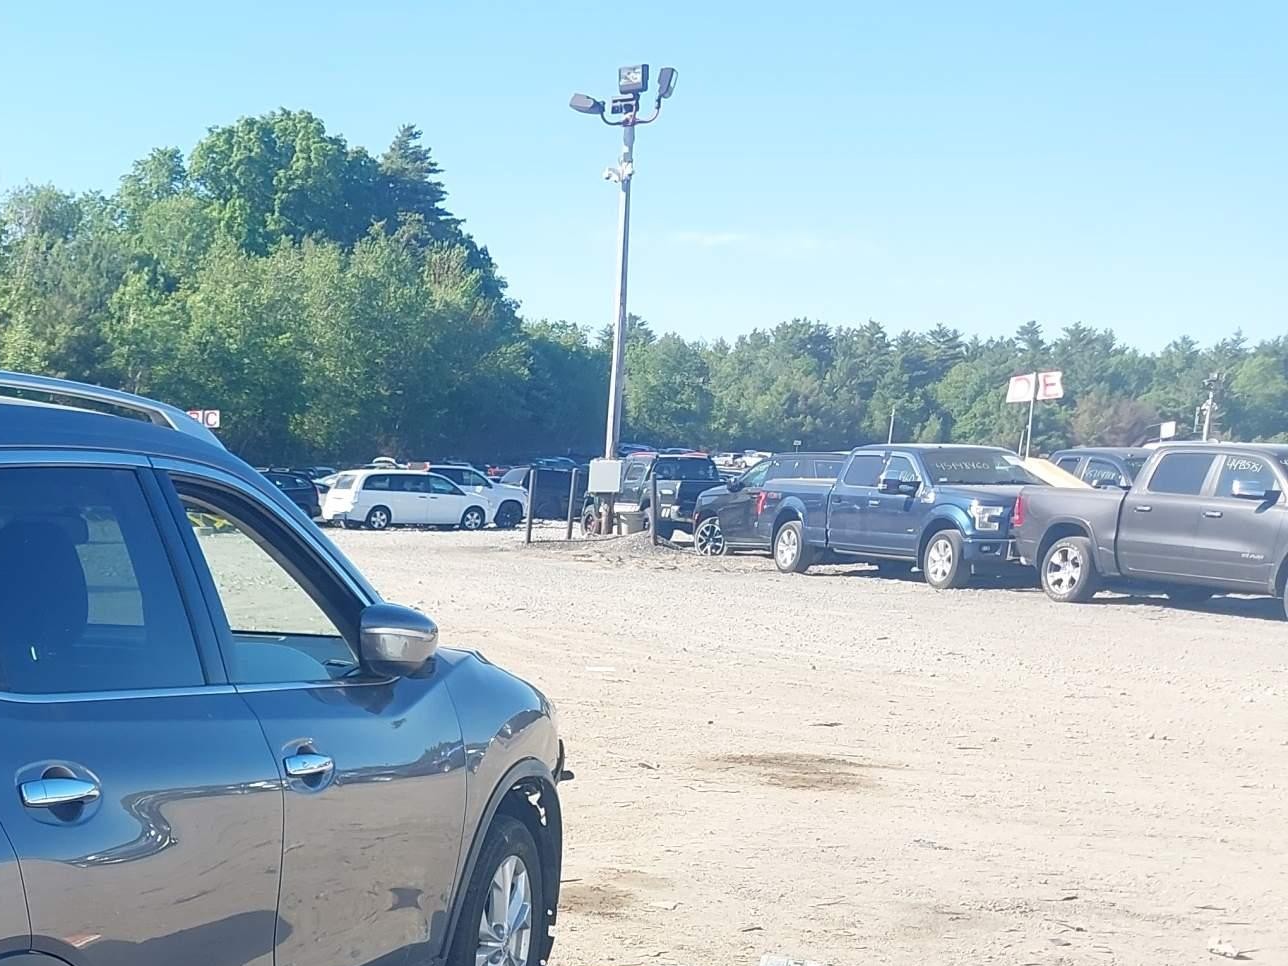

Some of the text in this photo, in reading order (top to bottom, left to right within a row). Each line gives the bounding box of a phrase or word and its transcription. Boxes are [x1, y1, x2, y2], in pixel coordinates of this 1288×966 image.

[1013, 374, 1059, 399] D E
[206, 411, 217, 426] C
